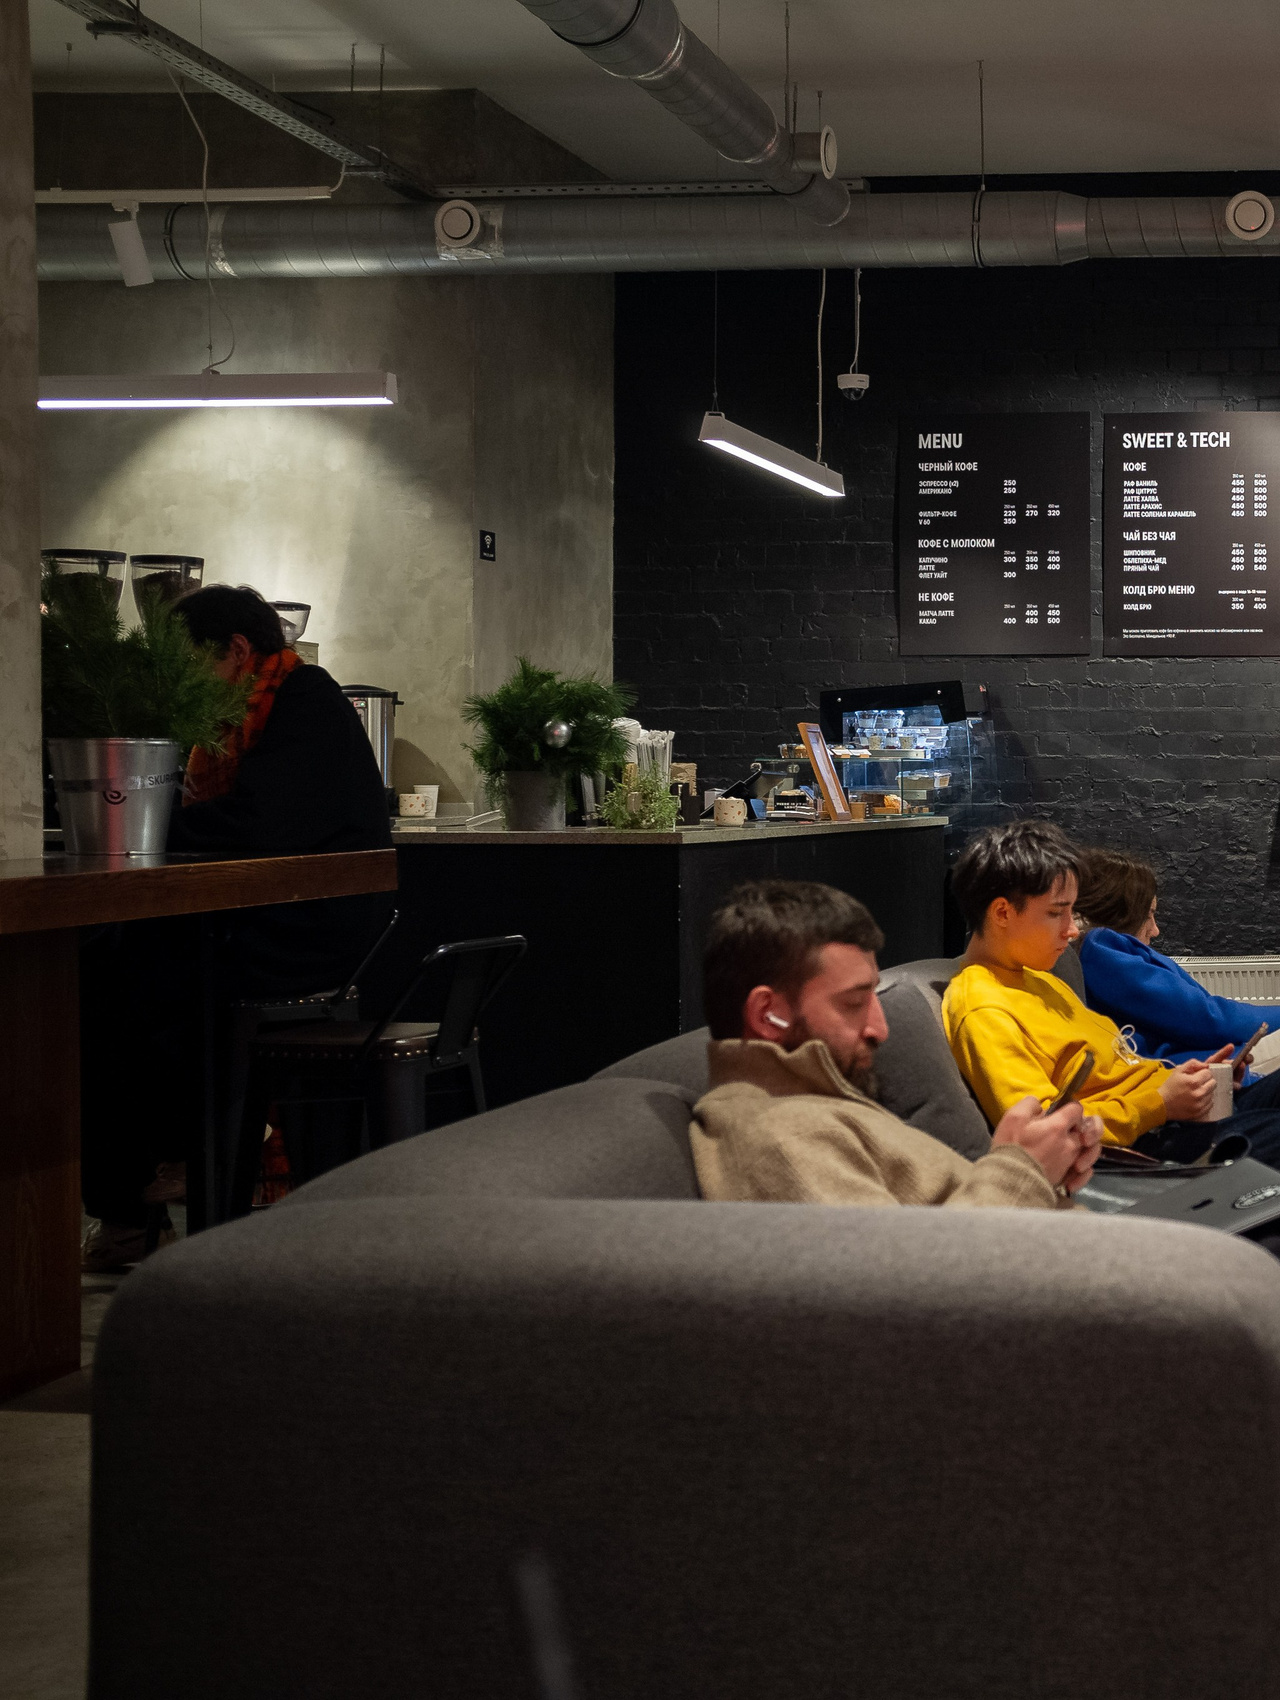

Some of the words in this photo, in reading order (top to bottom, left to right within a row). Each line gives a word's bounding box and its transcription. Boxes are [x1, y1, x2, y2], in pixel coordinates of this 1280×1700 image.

[919, 433, 962, 448] MENU
[1123, 433, 1174, 448] SWEET
[1177, 432, 1187, 447] &
[1190, 432, 1230, 447] TECH
[919, 460, 952, 471] ЧЕРНЫЙ
[955, 462, 978, 471] КОФЕ
[1124, 462, 1146, 471] КОФЕ
[1123, 530, 1140, 540] ЧАЙ
[1143, 531, 1157, 540] БЕЗ
[1159, 531, 1175, 540] ЧАЯ
[919, 539, 941, 548] КОФЕ
[943, 539, 948, 547] С
[951, 539, 994, 547] МОЛОКОМ
[1123, 586, 1146, 596] КОЛД
[1148, 586, 1166, 595] БРЮ
[1168, 585, 1195, 594] МЕНЮ
[919, 593, 929, 601] НЕ
[932, 593, 954, 601] КОФЕ
